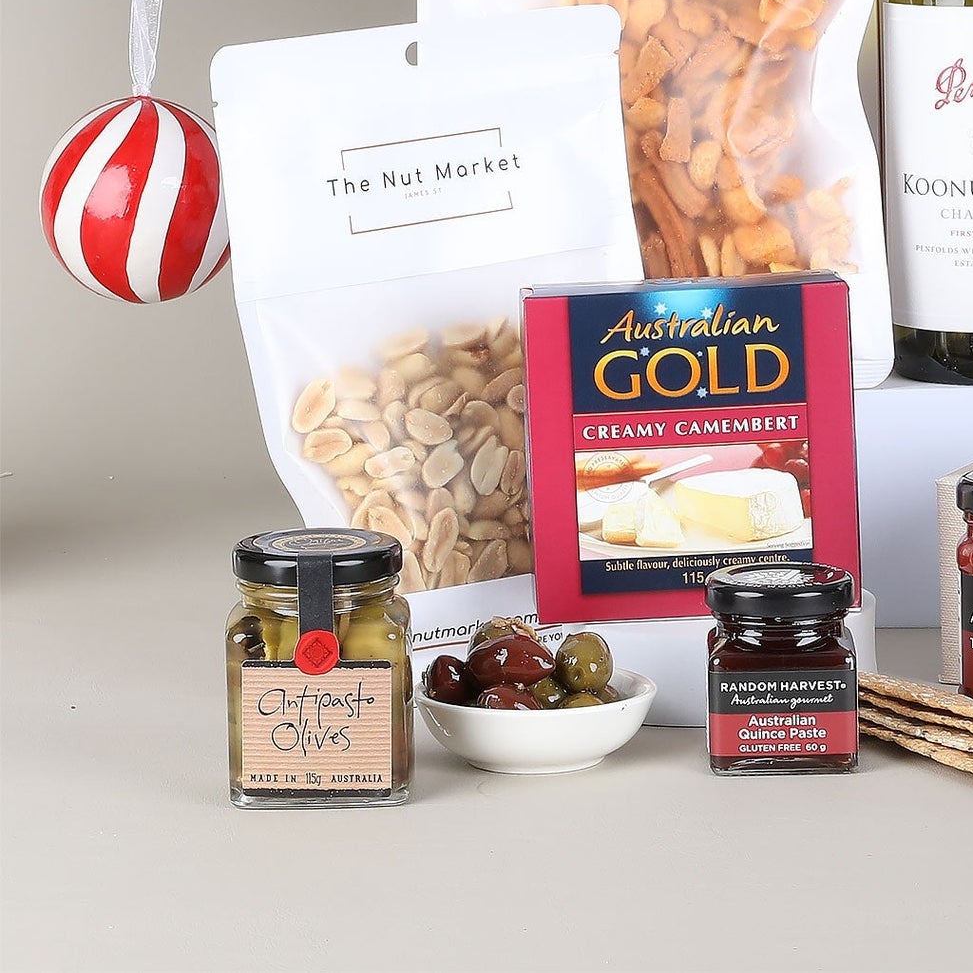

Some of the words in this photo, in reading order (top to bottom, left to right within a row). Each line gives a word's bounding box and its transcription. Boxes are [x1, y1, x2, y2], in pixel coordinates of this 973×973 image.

[327, 177, 370, 197] The
[382, 168, 423, 189] Nut
[435, 153, 521, 181] Market
[404, 189, 430, 199] JAMES
[600, 303, 779, 344] Australian
[593, 344, 791, 400] GOLD
[582, 422, 666, 440] CREAMY
[674, 415, 799, 437] CAMEMBERT
[605, 560, 634, 572] Subtle
[636, 559, 671, 571] flavour,
[672, 556, 721, 570] deliciously
[722, 555, 755, 566] creamy
[720, 682, 777, 692] RANDOM
[731, 692, 789, 706] Australian
[789, 694, 834, 709] gourmet
[748, 715, 816, 727] Australian
[271, 719, 351, 756] Olives
[738, 728, 786, 740] Quince
[789, 727, 827, 739] Paste
[739, 743, 776, 753] GLUTEN
[778, 743, 802, 752] FREE
[250, 774, 279, 783] MADE
[285, 774, 297, 783] IN
[305, 772, 322, 786] 115g
[331, 773, 383, 783] AUSTRALIA
